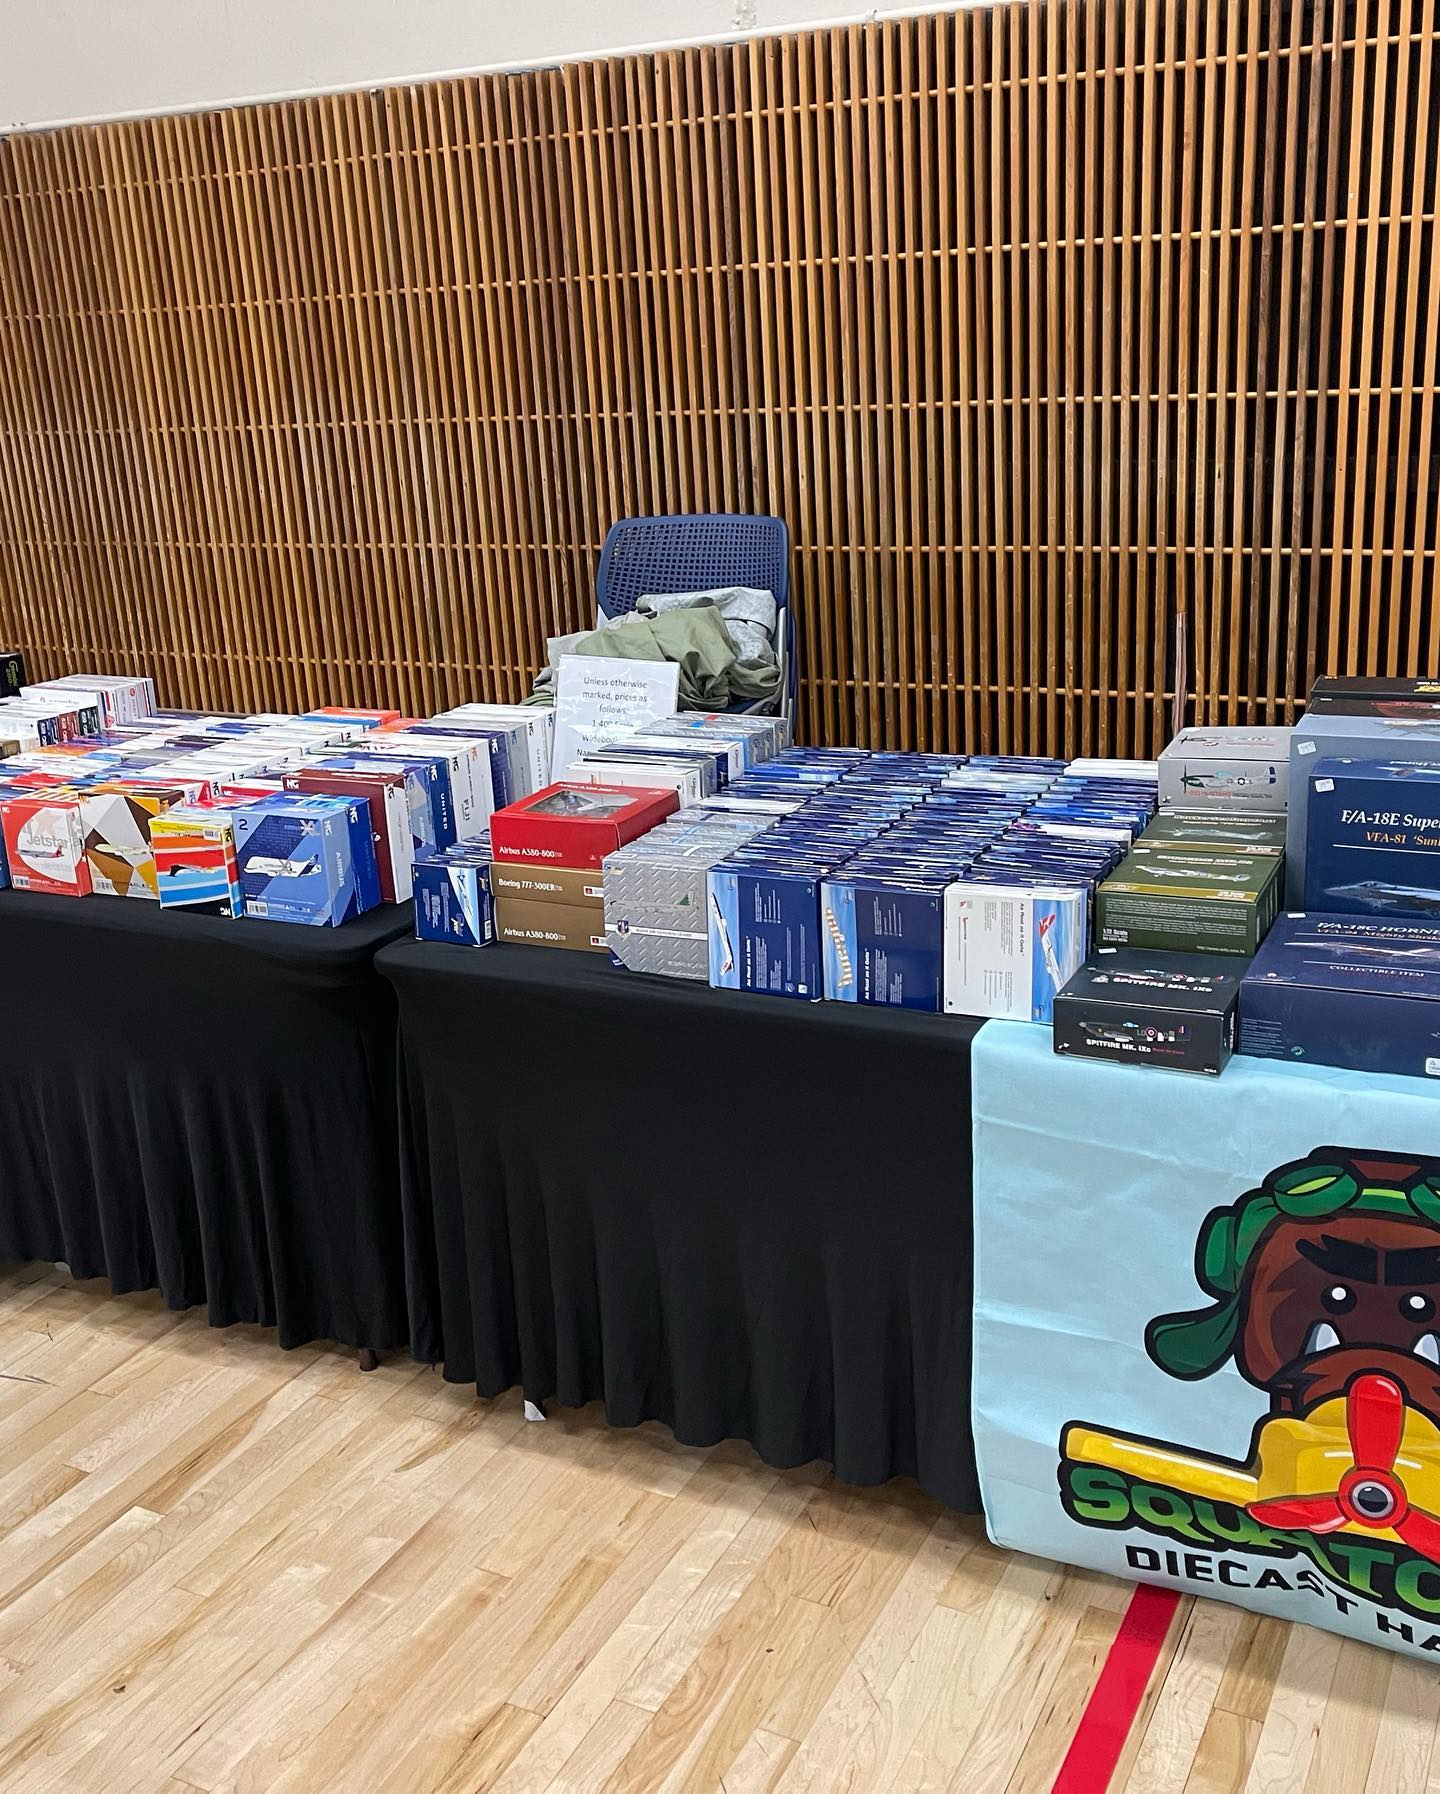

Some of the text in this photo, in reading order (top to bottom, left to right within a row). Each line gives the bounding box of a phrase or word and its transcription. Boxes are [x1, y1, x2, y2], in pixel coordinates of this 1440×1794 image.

[584, 677, 647, 689] Unless otherwise
[582, 691, 613, 700] marked,
[614, 693, 637, 702] prices
[286, 779, 299, 788] NG
[440, 793, 448, 830] UNITED
[238, 819, 248, 831] 2
[1341, 809, 1440, 831] F/A-18E Supe
[27, 834, 68, 849] Jetstar
[1366, 831, 1440, 847] VFA-81 'Sun
[499, 846, 521, 856] Airbus
[522, 848, 555, 858] A380-800
[499, 879, 521, 889] Boeing
[522, 881, 556, 891] 777-300ER
[1317, 922, 1379, 931] F/A-18C
[504, 928, 525, 938] Airbus
[526, 930, 559, 941] A380-800
[1329, 965, 1397, 975] COLLECTIBLE
[1113, 977, 1166, 988] SPITFIRE
[1167, 983, 1190, 991] MK.
[1086, 1038, 1121, 1050] SPITFIRE
[1122, 1043, 1137, 1051] MK.
[1125, 1545, 1358, 1615] DIECAST
